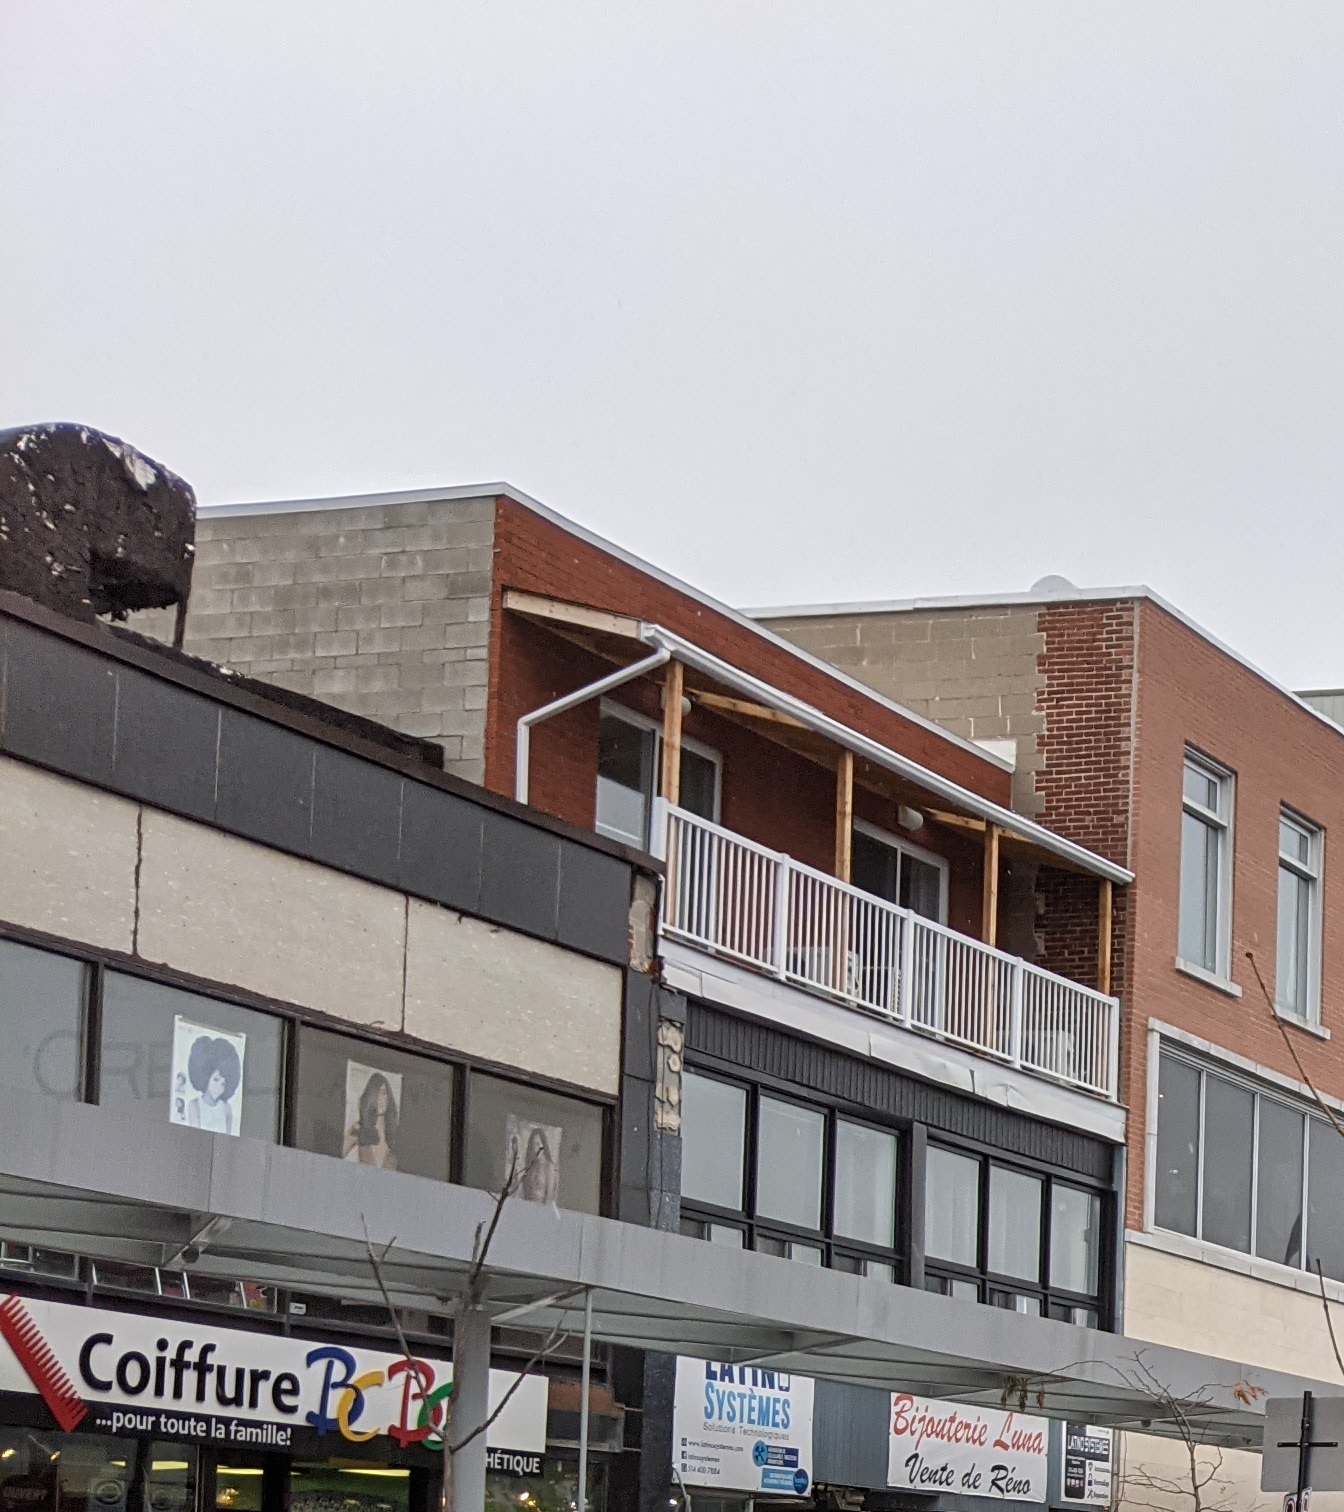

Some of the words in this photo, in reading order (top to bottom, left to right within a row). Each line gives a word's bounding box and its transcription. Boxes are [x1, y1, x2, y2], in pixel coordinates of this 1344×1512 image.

[79, 1332, 301, 1414] Coiffure
[704, 1382, 791, 1430] SYSTÈMES
[893, 1394, 988, 1451] Bijouterie
[993, 1412, 1045, 1454] Luna
[160, 1417, 207, 1438] toute
[211, 1421, 226, 1439] la
[230, 1422, 292, 1446] famille!
[703, 1422, 736, 1434] Solutions
[739, 1426, 790, 1441] Technologiques
[486, 1451, 541, 1475] HÉTIQUE
[905, 1452, 955, 1486] Vente
[962, 1462, 982, 1490] de
[989, 1464, 1032, 1495] Réno
